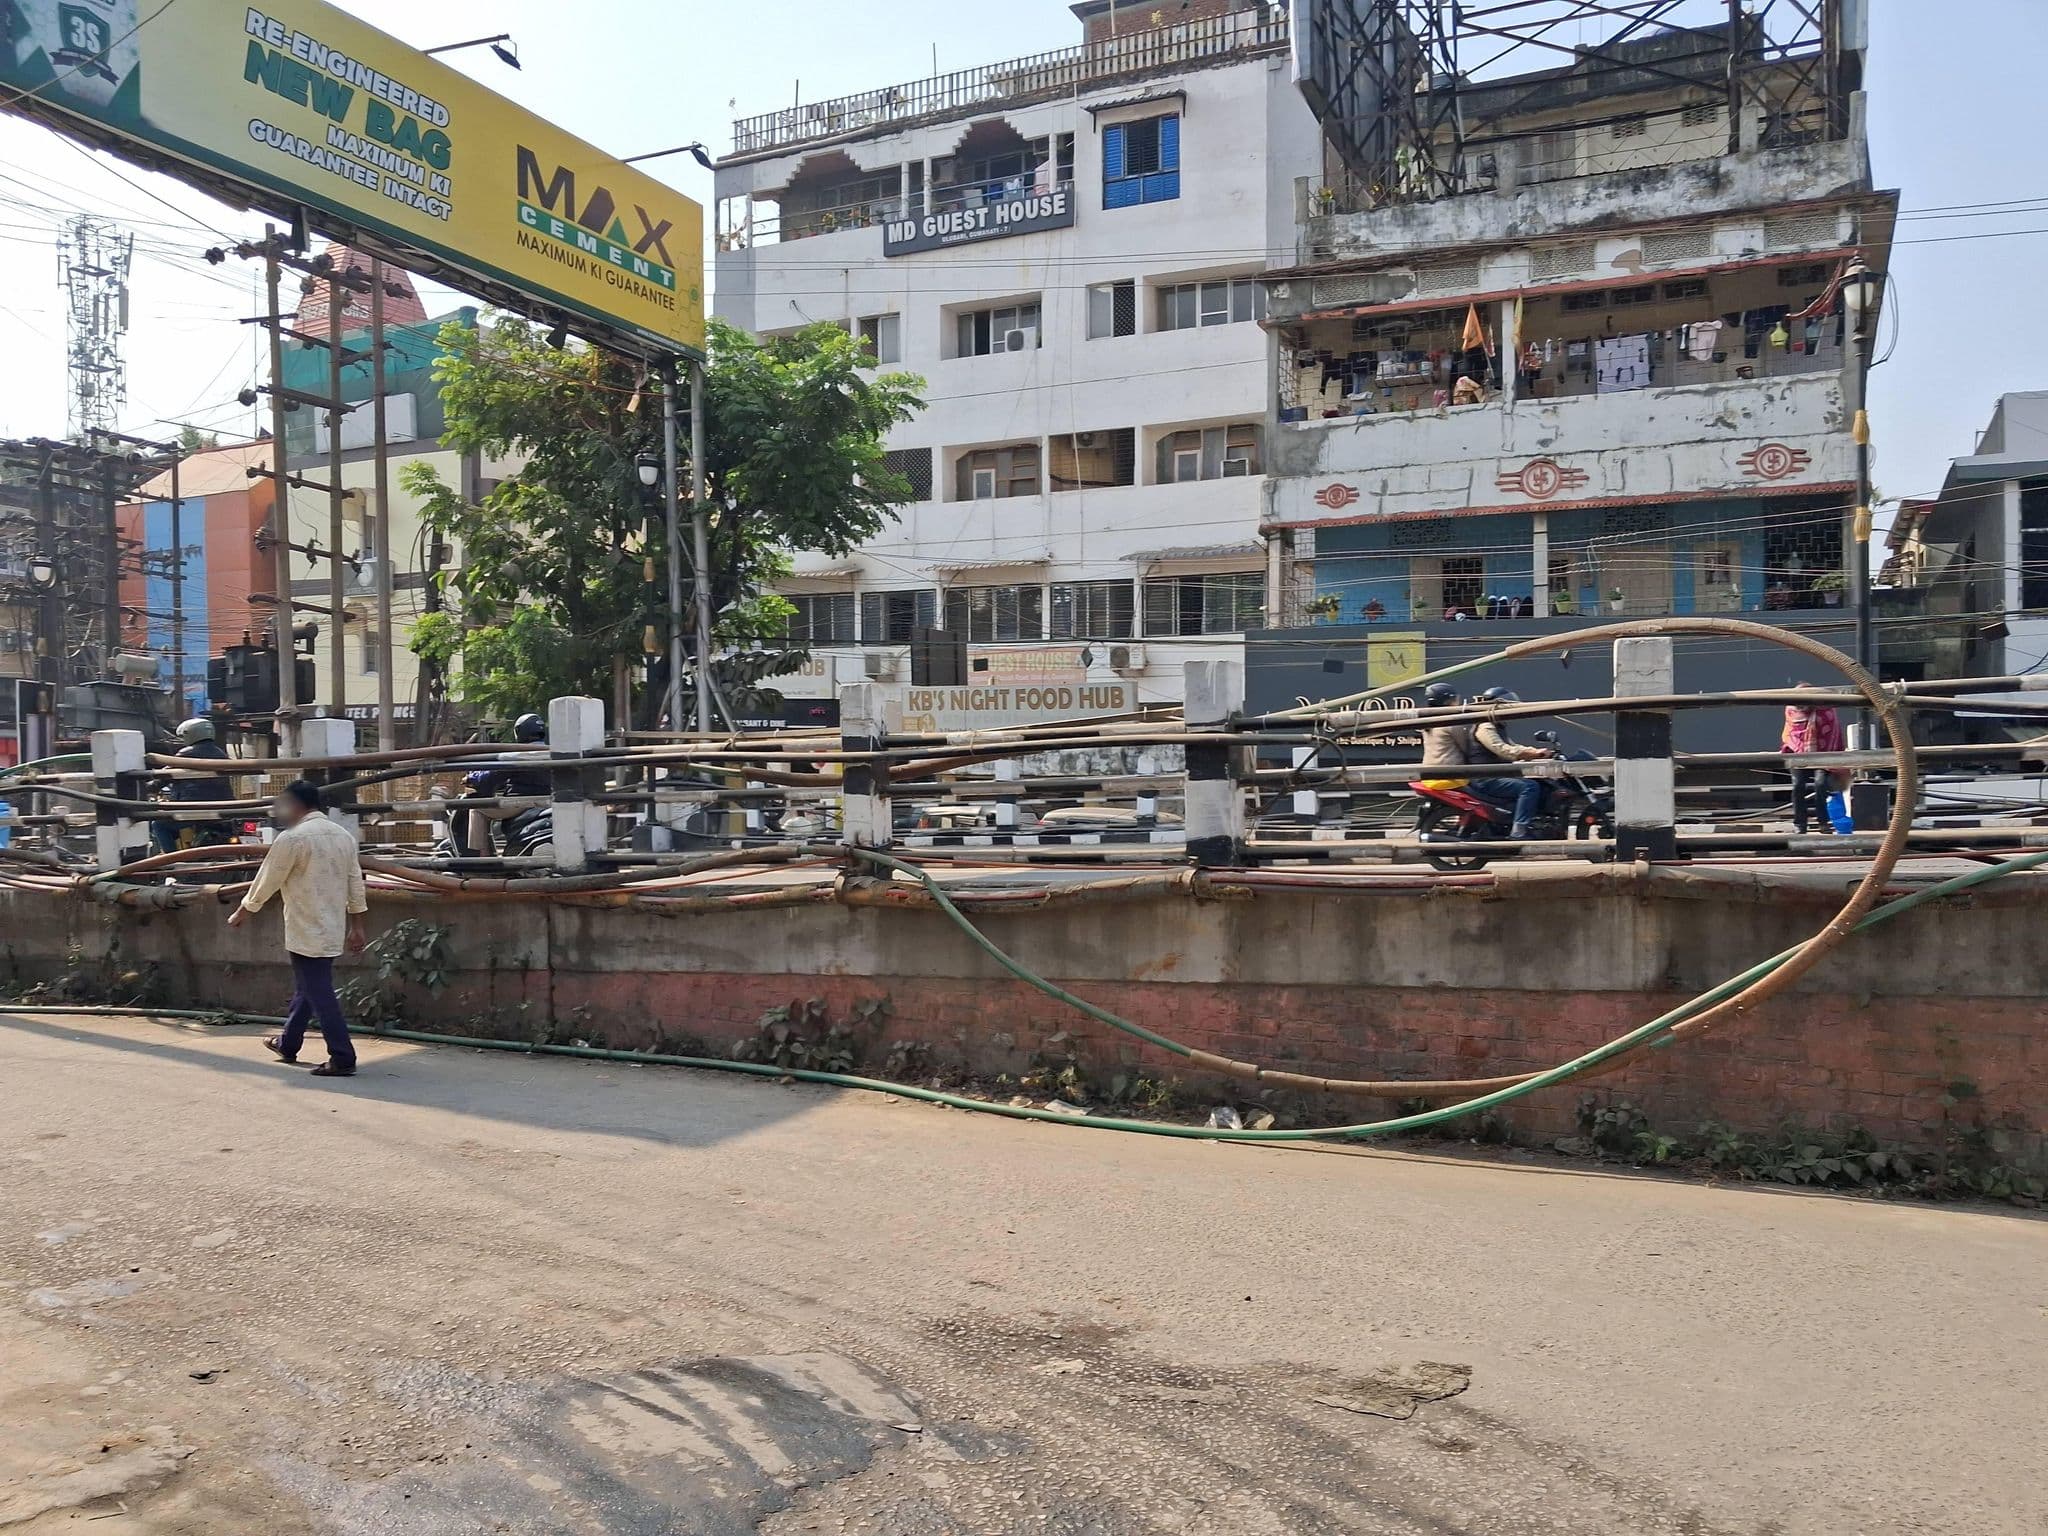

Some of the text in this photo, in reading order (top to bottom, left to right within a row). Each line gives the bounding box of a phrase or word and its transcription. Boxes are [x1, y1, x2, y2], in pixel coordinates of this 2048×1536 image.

[71, 16, 101, 54] 3S
[245, 7, 450, 128] RE-ENGINEERED
[244, 39, 453, 170] NEW BAG
[248, 118, 453, 222] GUARANTEE INTACT
[326, 124, 452, 198] MAXIMUM KI
[517, 143, 676, 270] MAX
[521, 205, 673, 287] CEMENT
[887, 193, 1067, 244] MD GUEST HOUSE
[517, 230, 675, 312] MAXIMUM KI GUARANTEE
[908, 686, 1125, 712] KB'S NIGHT FOOD HUB
[1026, 652, 1073, 671] HOUSE
